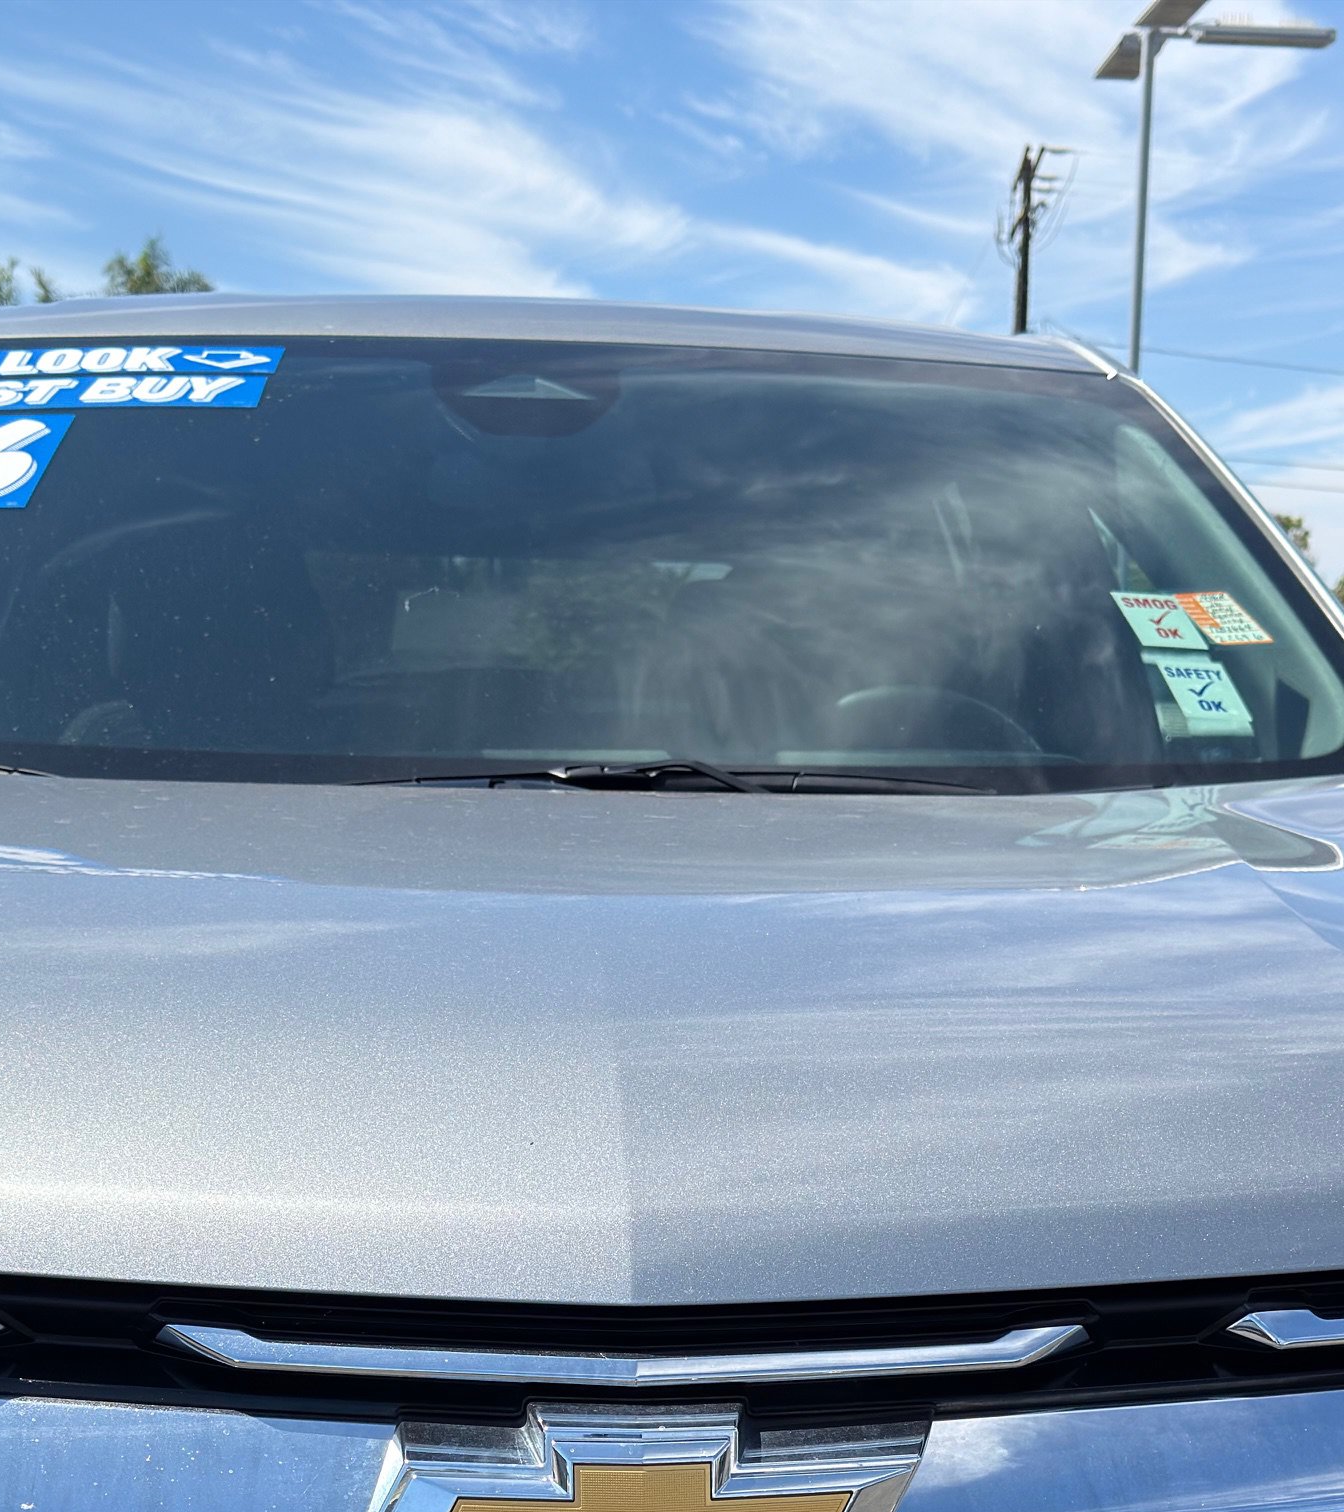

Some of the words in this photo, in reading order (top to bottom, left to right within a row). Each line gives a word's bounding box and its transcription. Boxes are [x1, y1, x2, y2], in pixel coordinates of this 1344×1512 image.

[79, 376, 246, 404] BUY
[1120, 597, 1179, 611] SMOG
[1156, 627, 1184, 640] OK
[1164, 666, 1224, 681] SAFETY
[1197, 699, 1228, 713] OK
